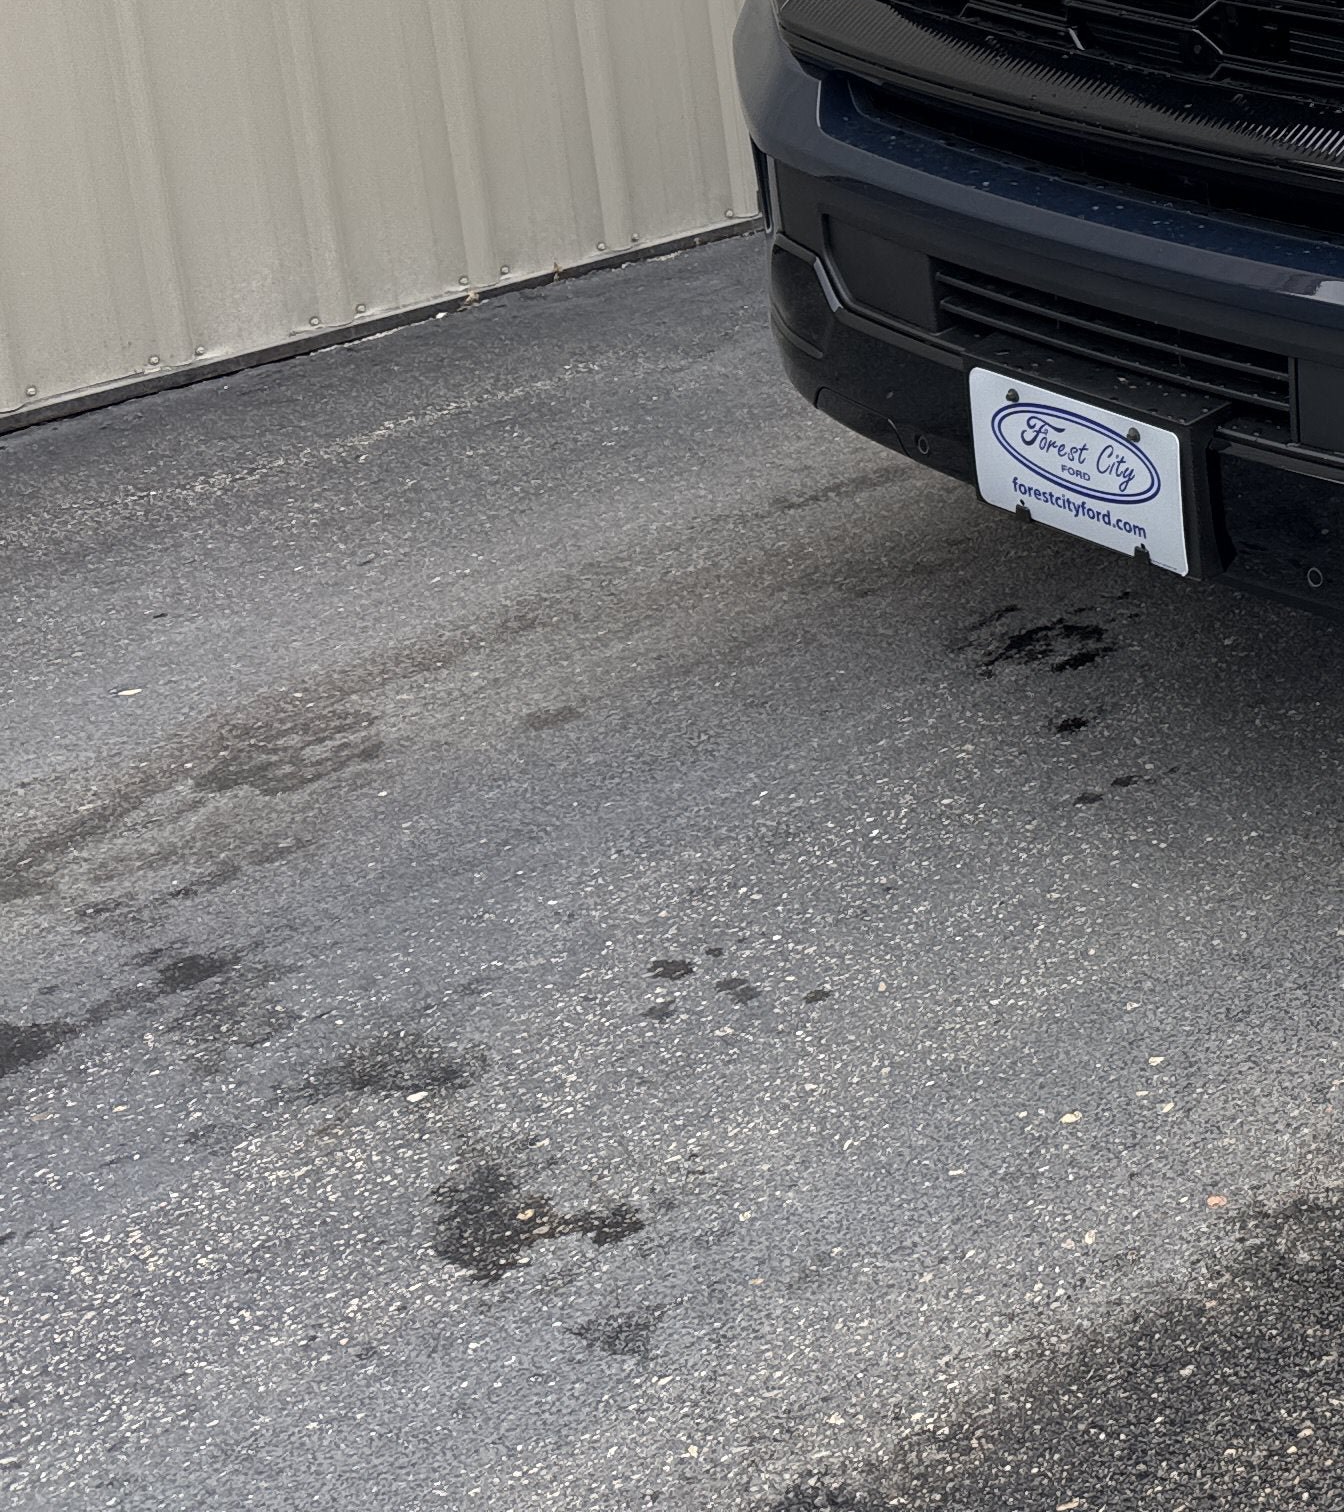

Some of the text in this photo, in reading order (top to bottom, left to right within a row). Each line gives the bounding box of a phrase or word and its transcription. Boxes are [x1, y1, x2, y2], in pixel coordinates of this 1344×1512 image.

[1020, 415, 1135, 492] Forest City
[1060, 464, 1091, 482] FORD
[1012, 476, 1147, 539] forestcityford.com
